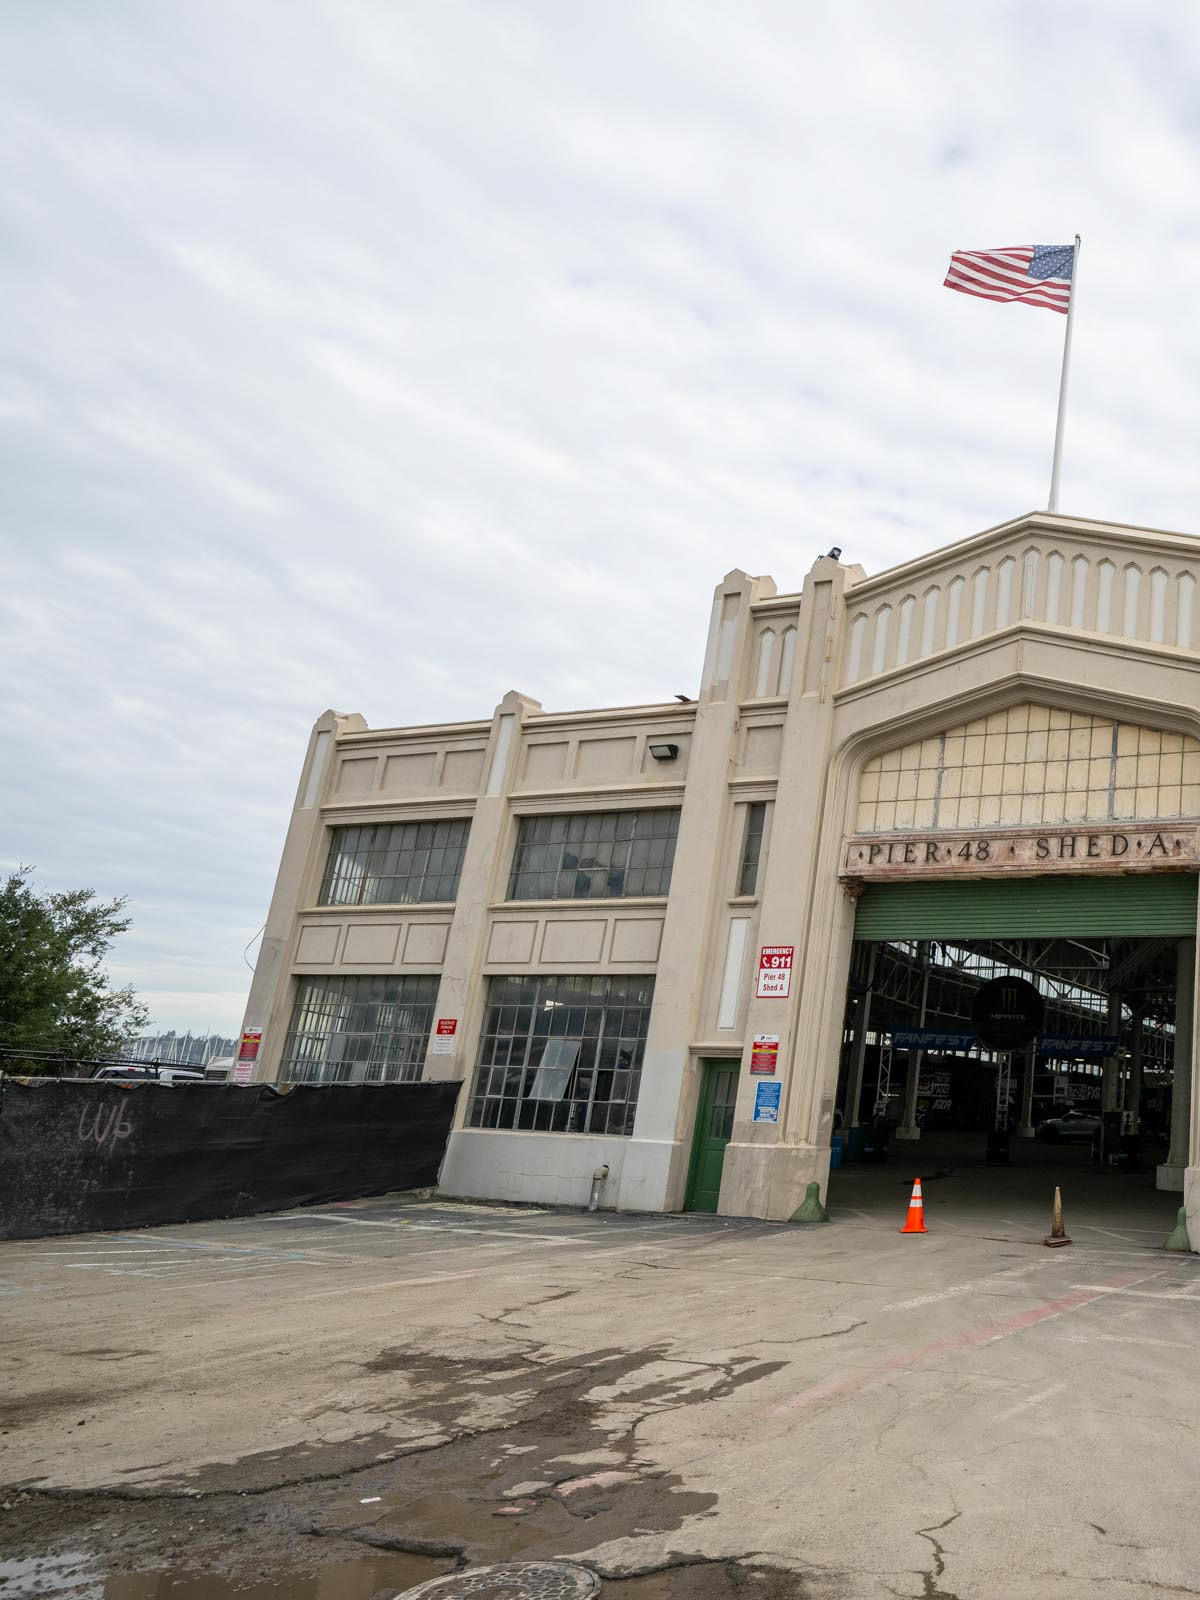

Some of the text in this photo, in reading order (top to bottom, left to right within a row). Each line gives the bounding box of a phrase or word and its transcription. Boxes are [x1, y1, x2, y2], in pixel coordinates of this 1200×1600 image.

[867, 832, 1169, 865] PIER 48 SHED A
[771, 956, 791, 968] 911
[763, 973, 776, 981] Pier
[762, 983, 778, 991] Shed
[893, 1032, 974, 1046] FANFEST
[1041, 1038, 1116, 1052] FANFEST
